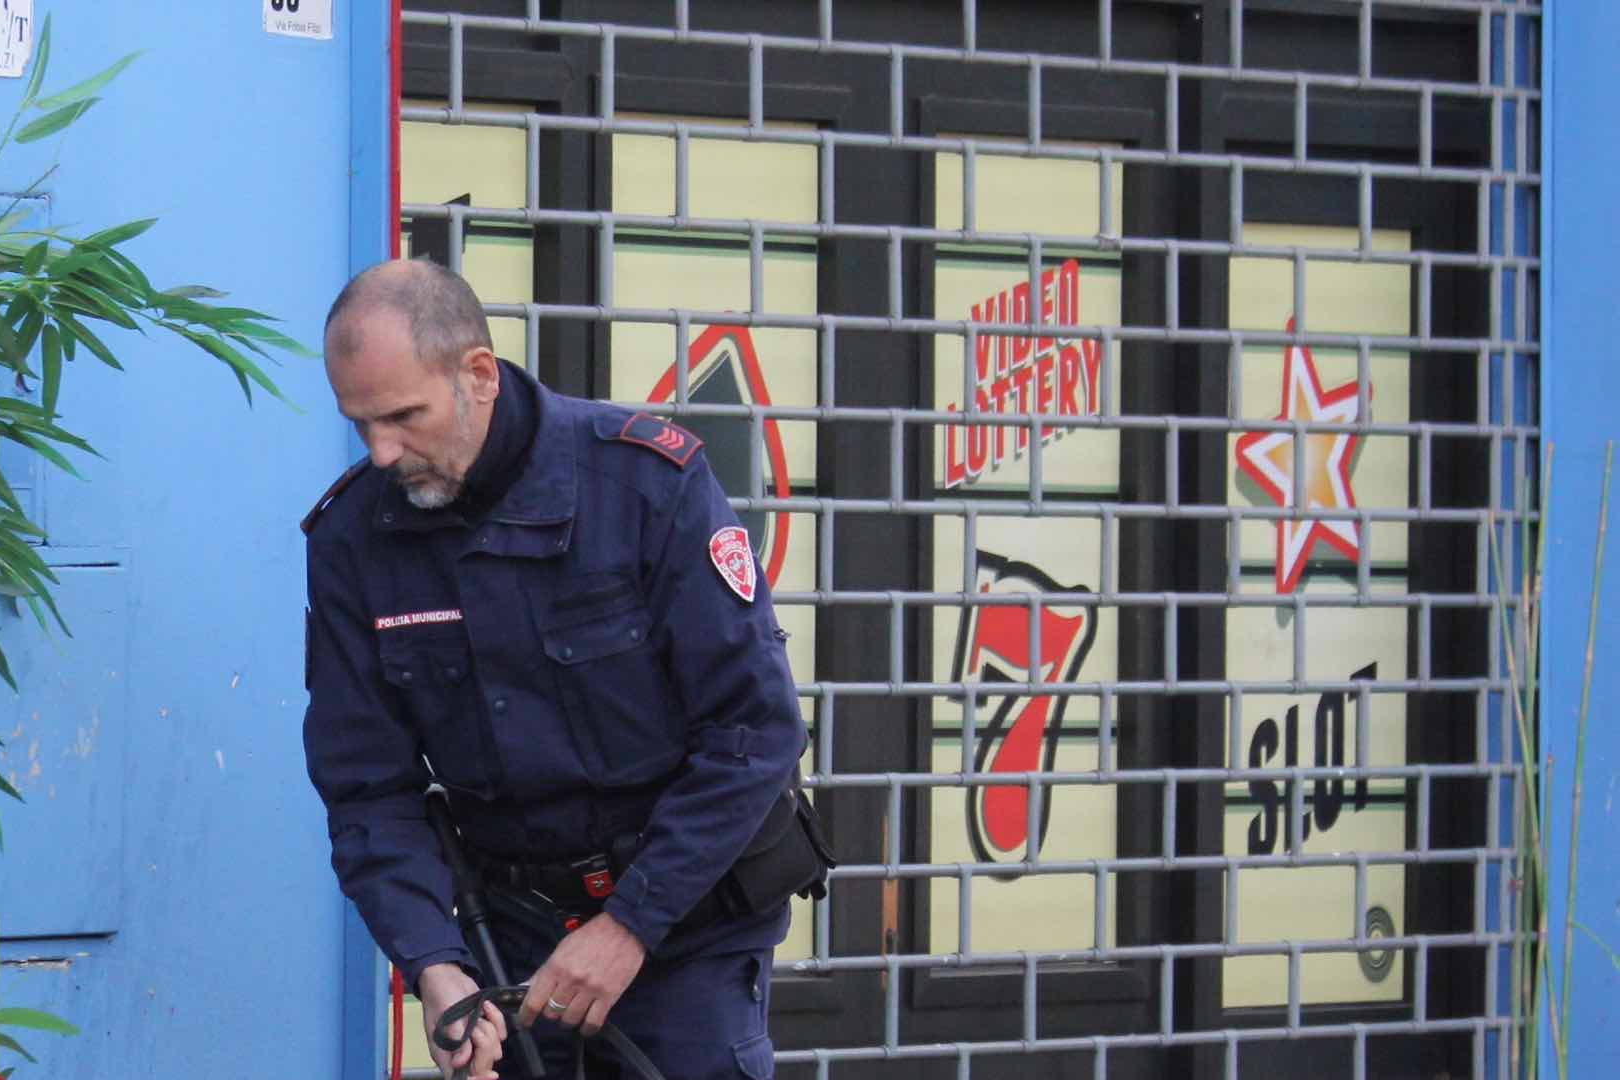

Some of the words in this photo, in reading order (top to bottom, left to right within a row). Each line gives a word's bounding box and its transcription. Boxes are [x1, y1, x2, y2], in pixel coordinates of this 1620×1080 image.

[970, 258, 1080, 386] VIDEO
[944, 336, 1104, 490] LOTTERY
[376, 615, 411, 630] POLIZIA
[1246, 660, 1379, 858] SLOT
